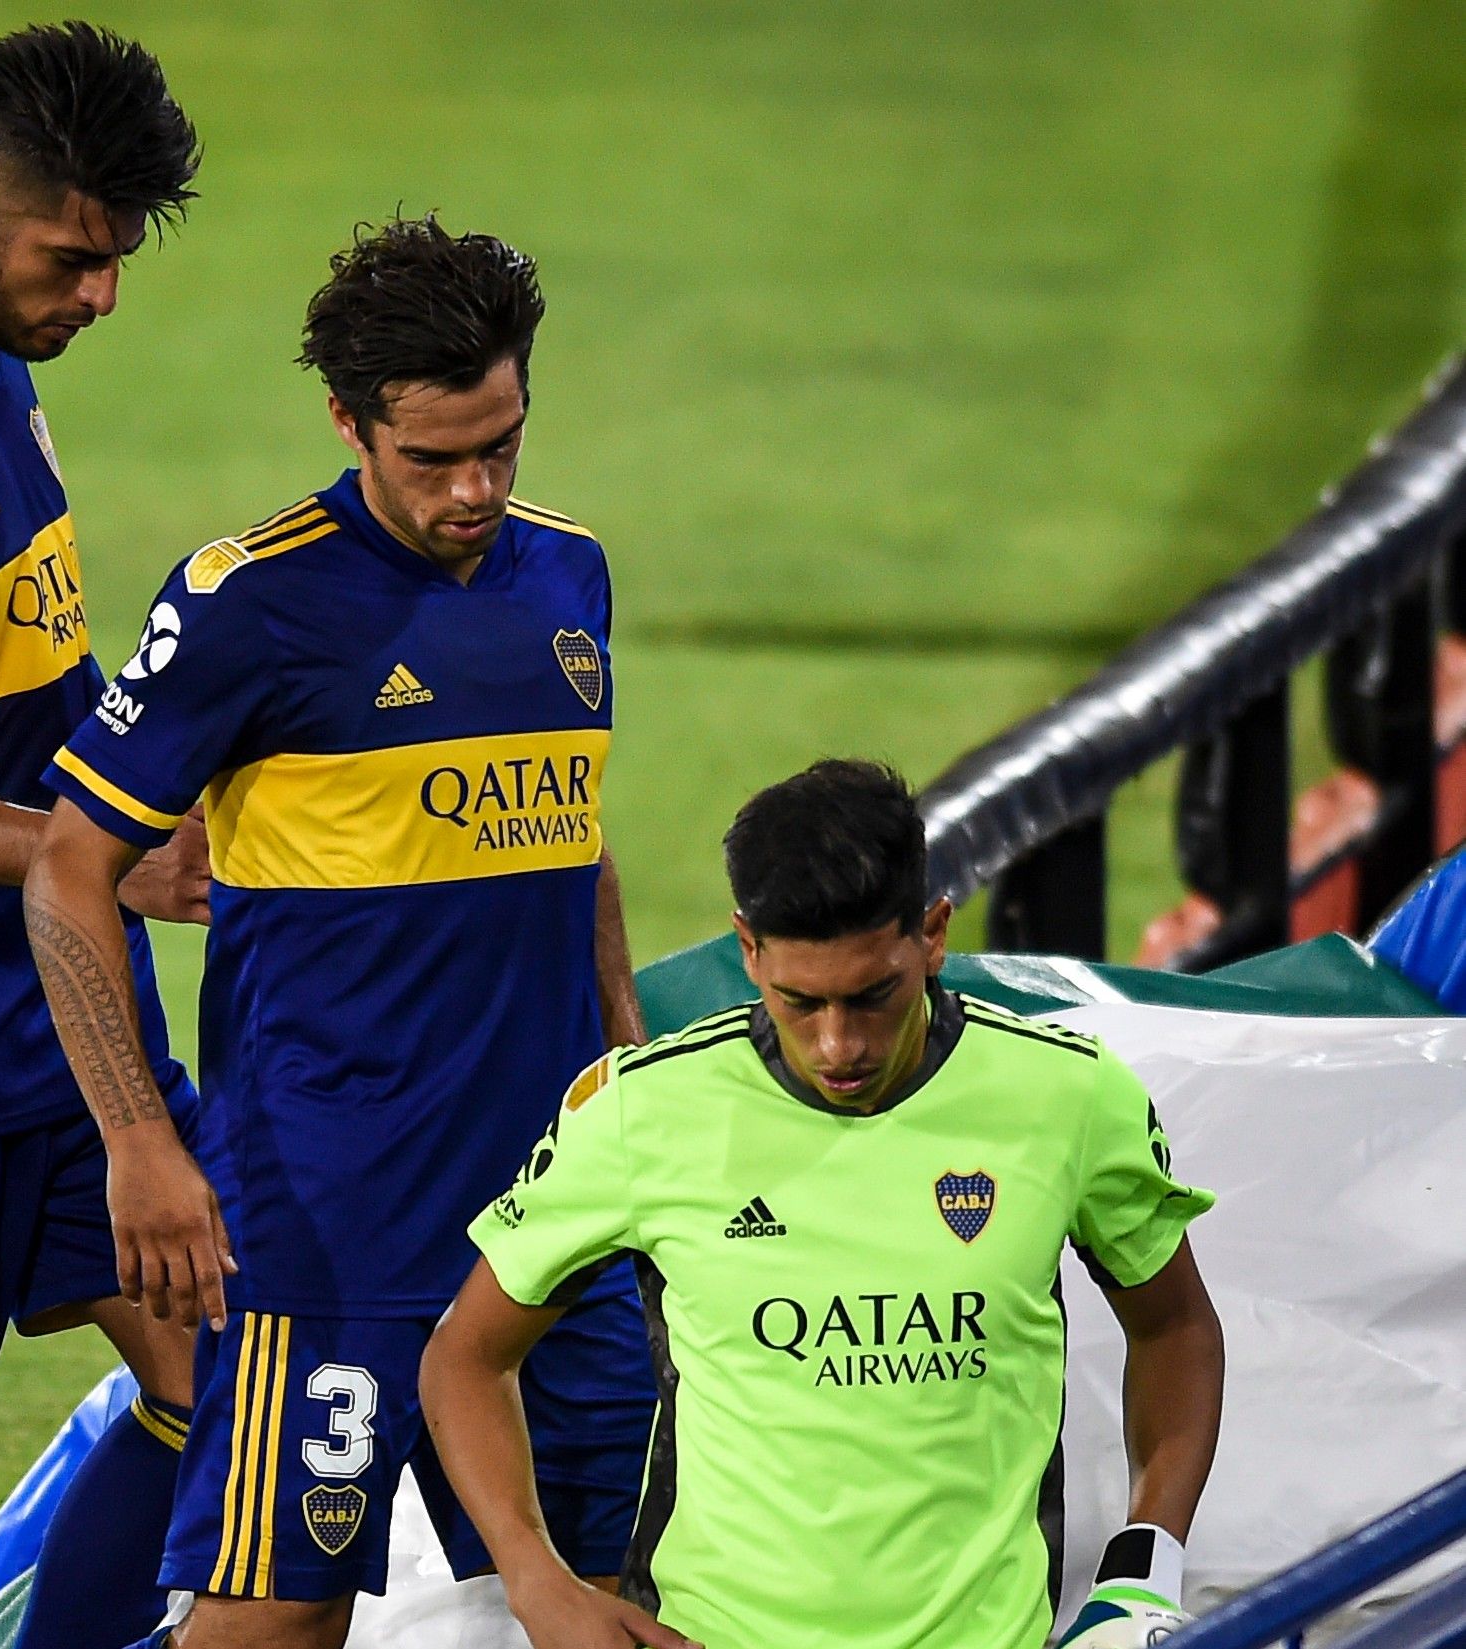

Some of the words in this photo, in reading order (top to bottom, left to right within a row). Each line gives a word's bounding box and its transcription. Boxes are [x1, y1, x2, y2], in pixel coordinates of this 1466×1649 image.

[564, 655, 597, 672] CABJ
[374, 687, 434, 709] adidas
[420, 755, 591, 829] QATAR
[474, 812, 590, 852] AIRWAYS
[940, 1194, 991, 1210] CABJ
[724, 1221, 788, 1240] adidas
[752, 1291, 988, 1362] QATAR
[815, 1347, 988, 1387] AIRWAYS
[301, 1362, 379, 1480] 3
[312, 1509, 356, 1523] CABJ
